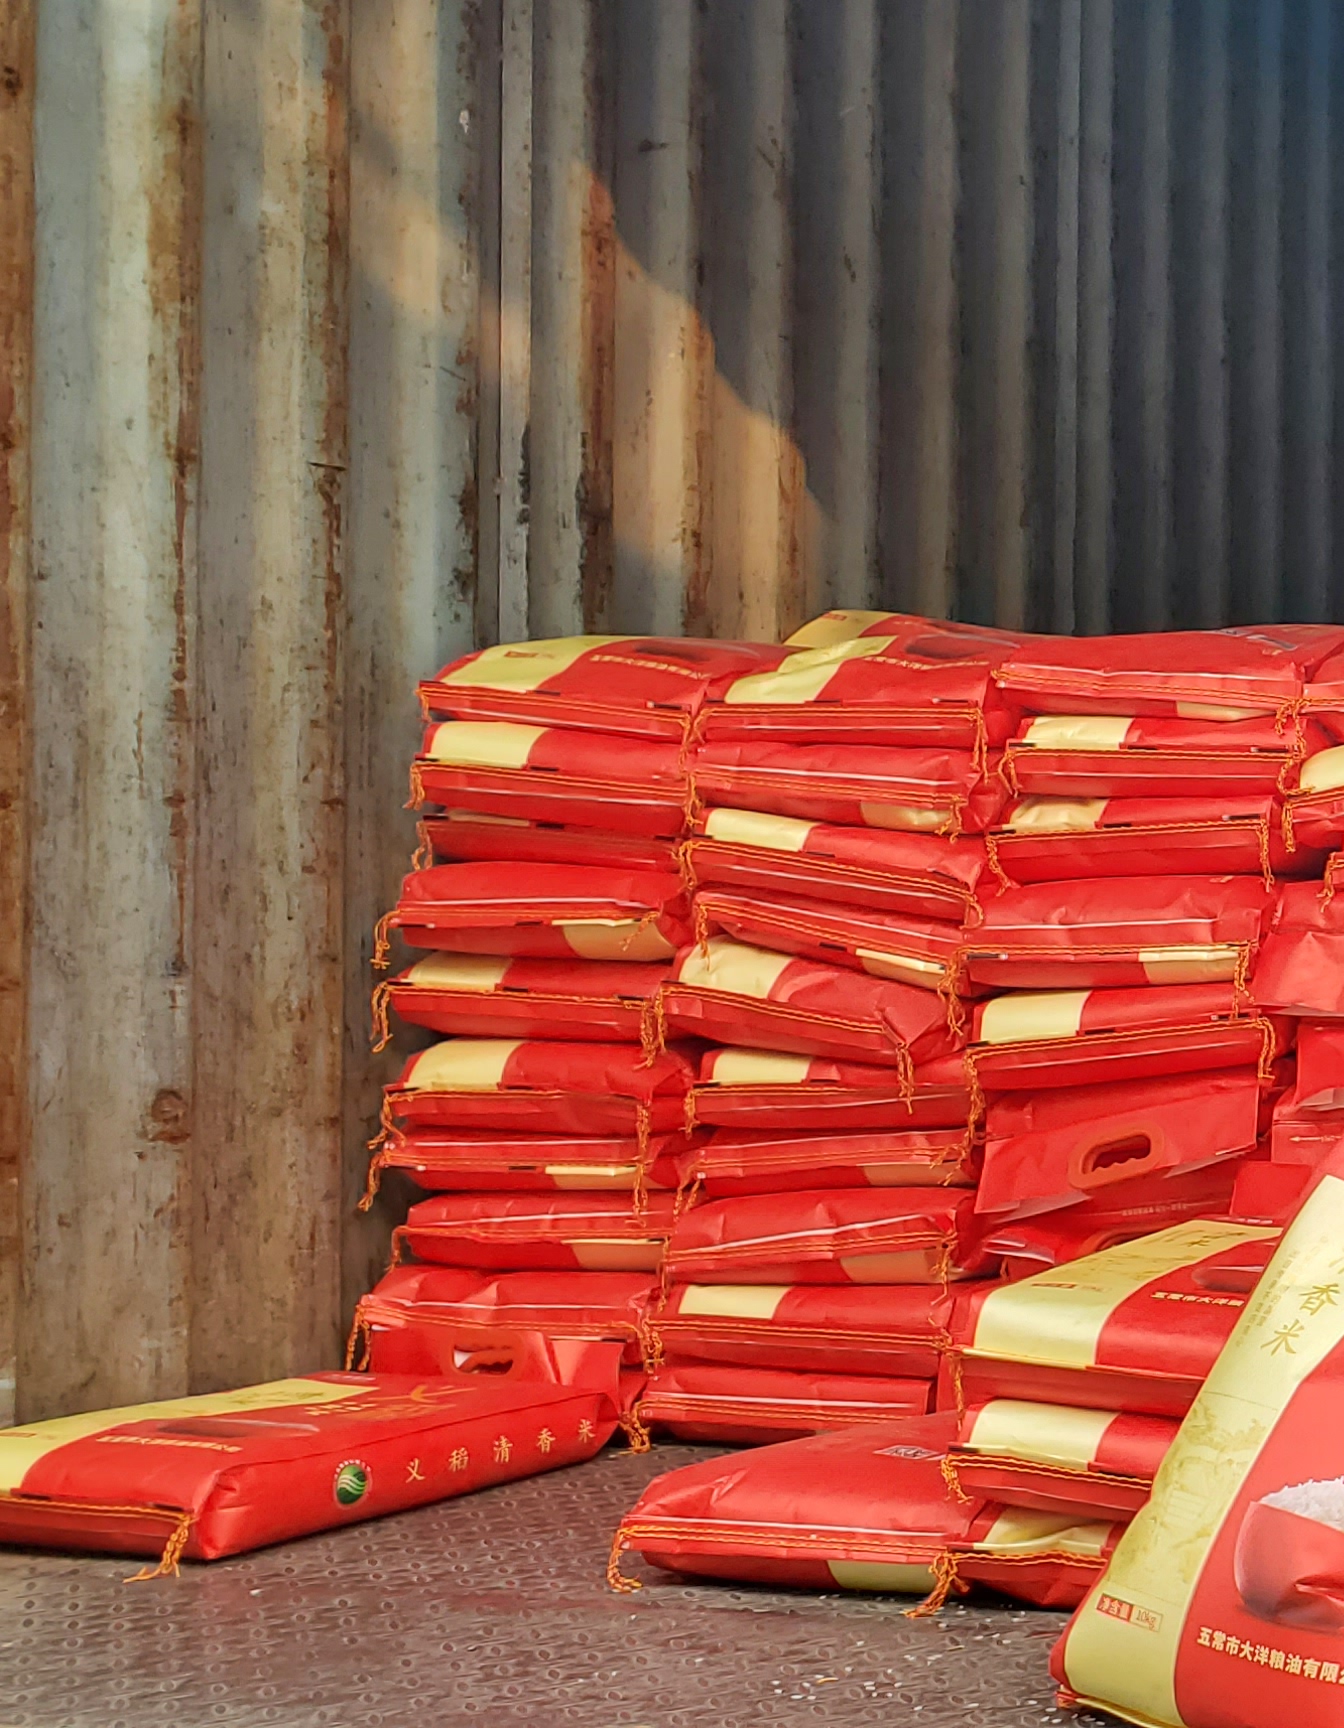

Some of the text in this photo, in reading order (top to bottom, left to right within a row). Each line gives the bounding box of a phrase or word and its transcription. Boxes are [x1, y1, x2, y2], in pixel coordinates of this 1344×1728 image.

[405, 1418, 596, 1483] 义稻清香米
